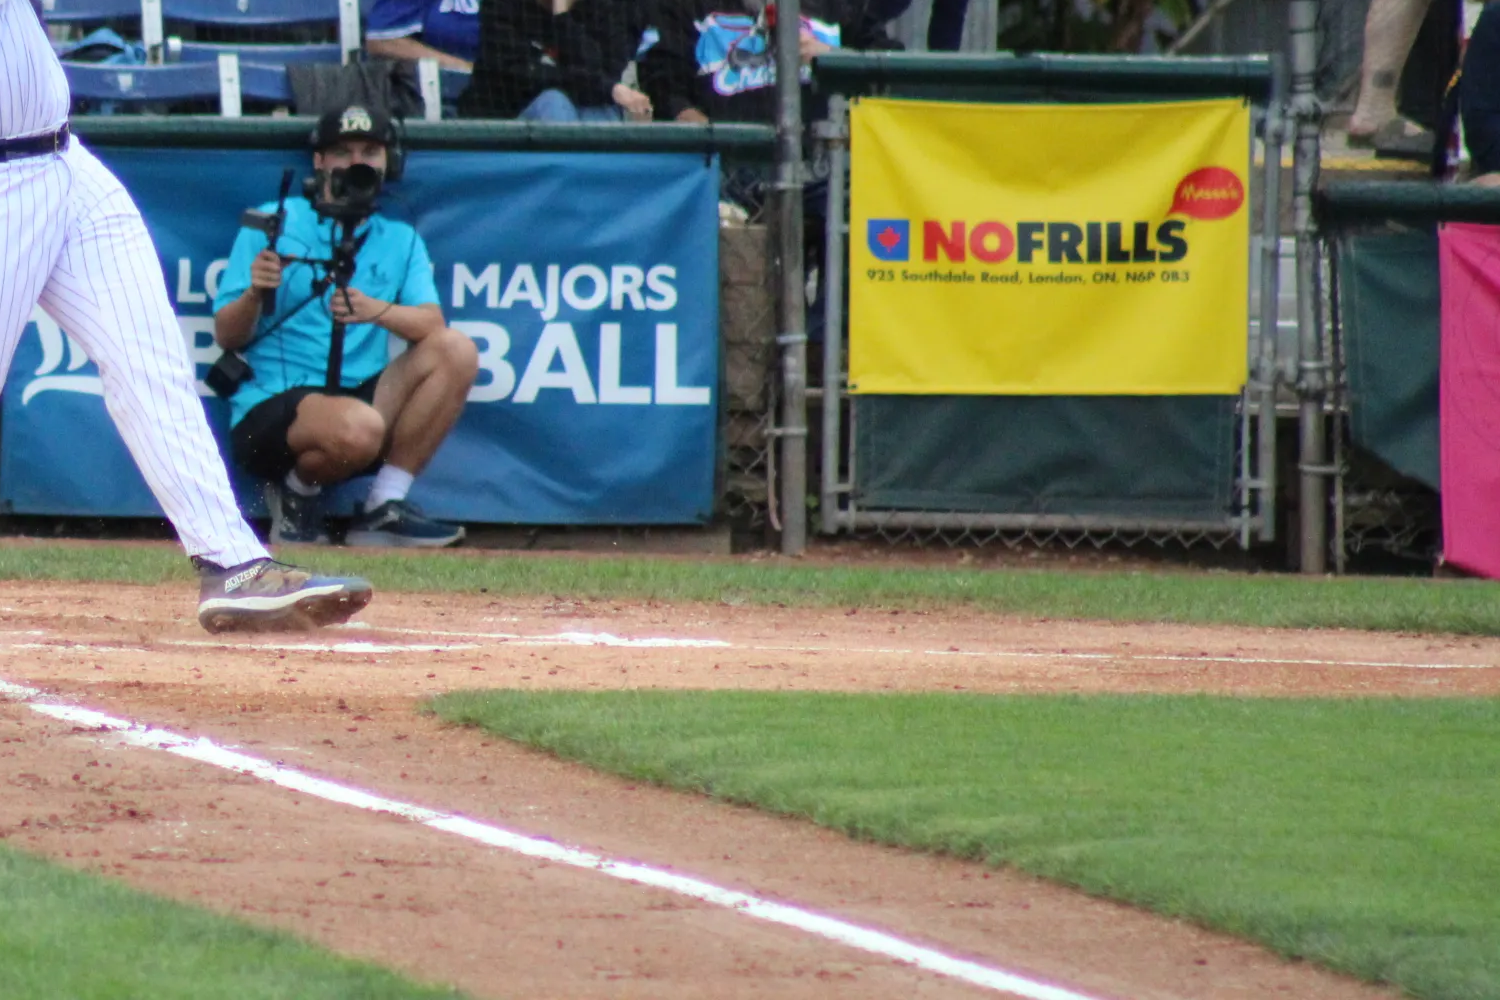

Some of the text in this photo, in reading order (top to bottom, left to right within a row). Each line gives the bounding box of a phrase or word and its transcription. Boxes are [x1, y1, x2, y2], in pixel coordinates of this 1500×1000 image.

[451, 262, 678, 321] MAJORS
[866, 269, 895, 282] 925
[901, 269, 976, 284] Southdale
[980, 271, 1024, 285] Road,
[1028, 270, 1087, 285] London,
